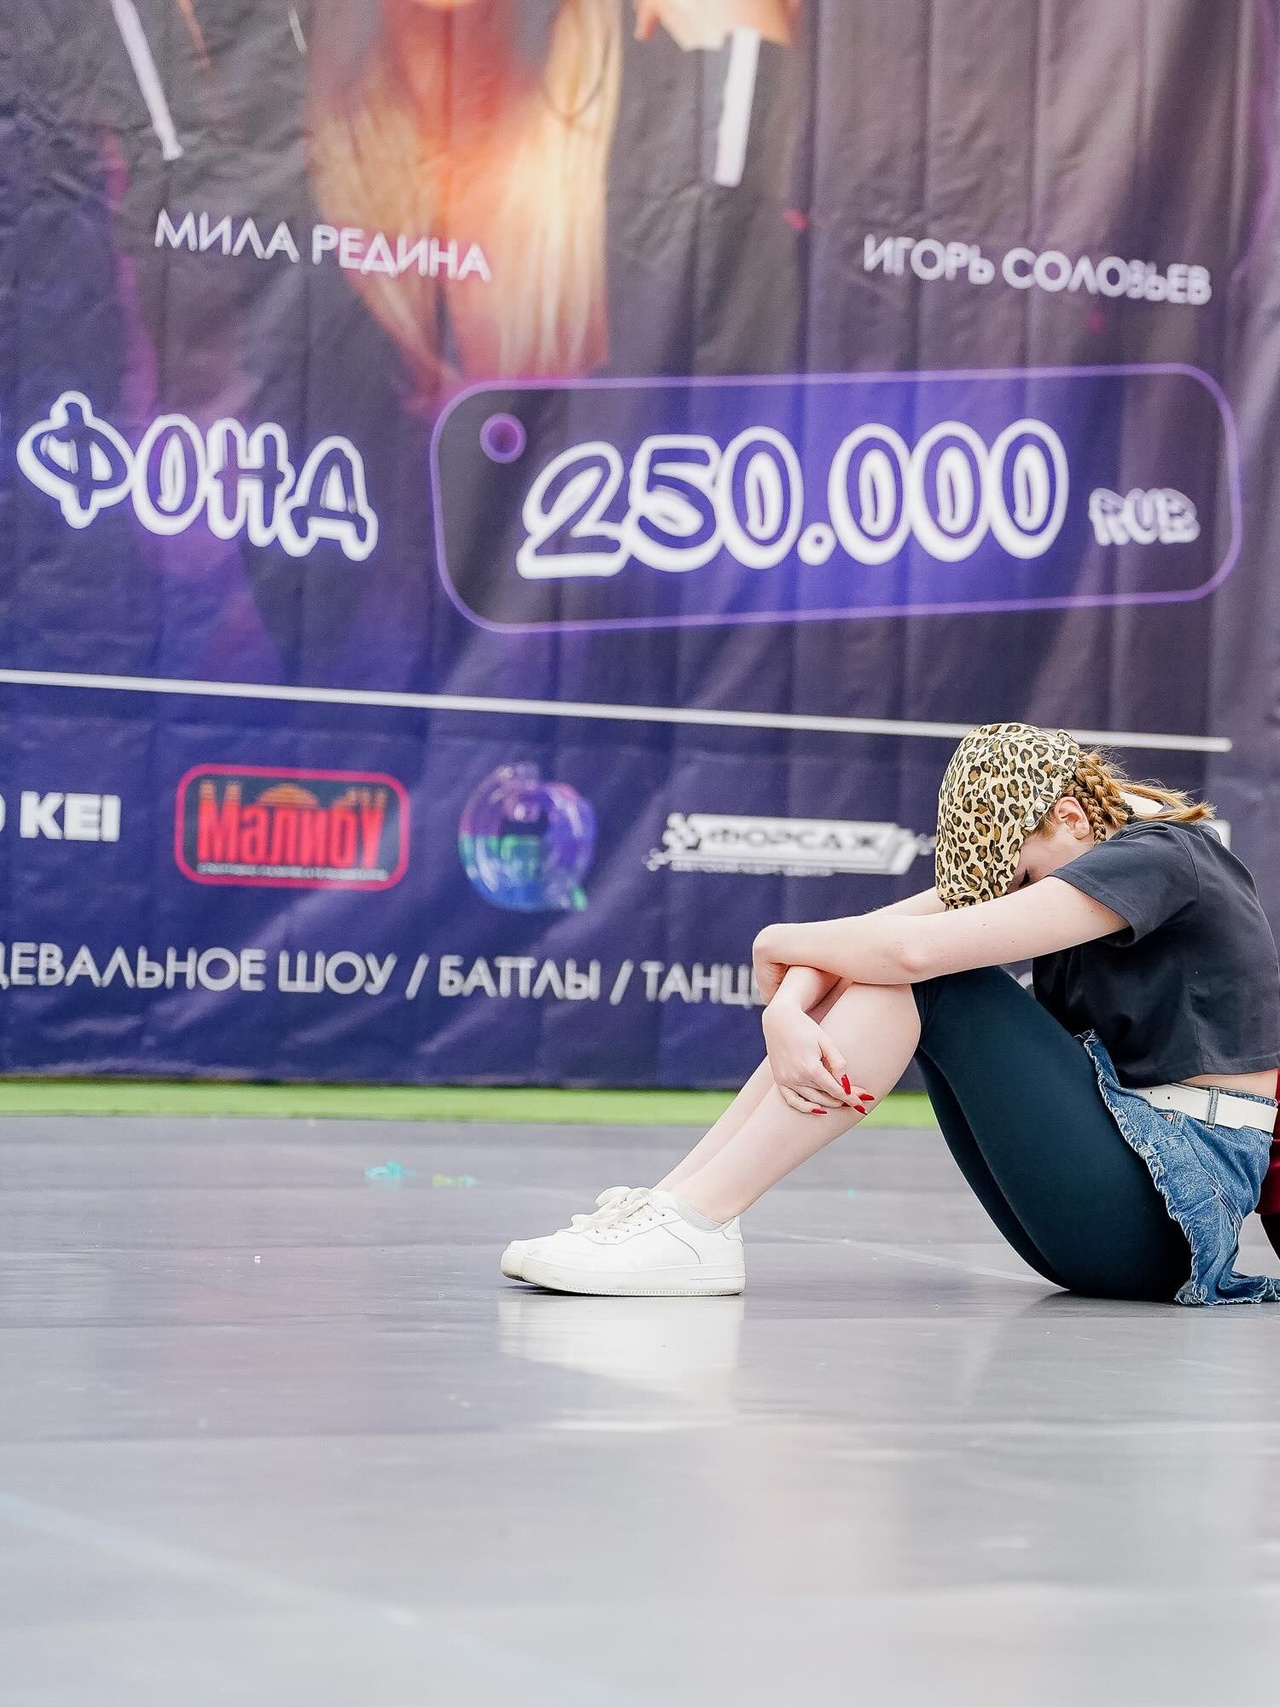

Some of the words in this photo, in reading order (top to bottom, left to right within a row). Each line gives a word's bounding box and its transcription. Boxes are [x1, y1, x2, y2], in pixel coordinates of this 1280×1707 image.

[154, 208, 300, 263] МИЛА
[312, 223, 492, 283] РЕДИНА
[863, 233, 996, 285] ИГОРЬ
[1002, 246, 1212, 305] СОЛОВЬЕВ
[16, 390, 379, 562] ФОНД
[516, 418, 1069, 580] 250.000
[1088, 487, 1201, 546] RUB
[20, 790, 121, 842] KEI
[0, 941, 267, 992] ЕВАЛЬНОЕ
[278, 950, 398, 995] ШОУ
[438, 953, 601, 1001] БАТТЛЫ
[640, 959, 767, 1009] ТАНЦ
